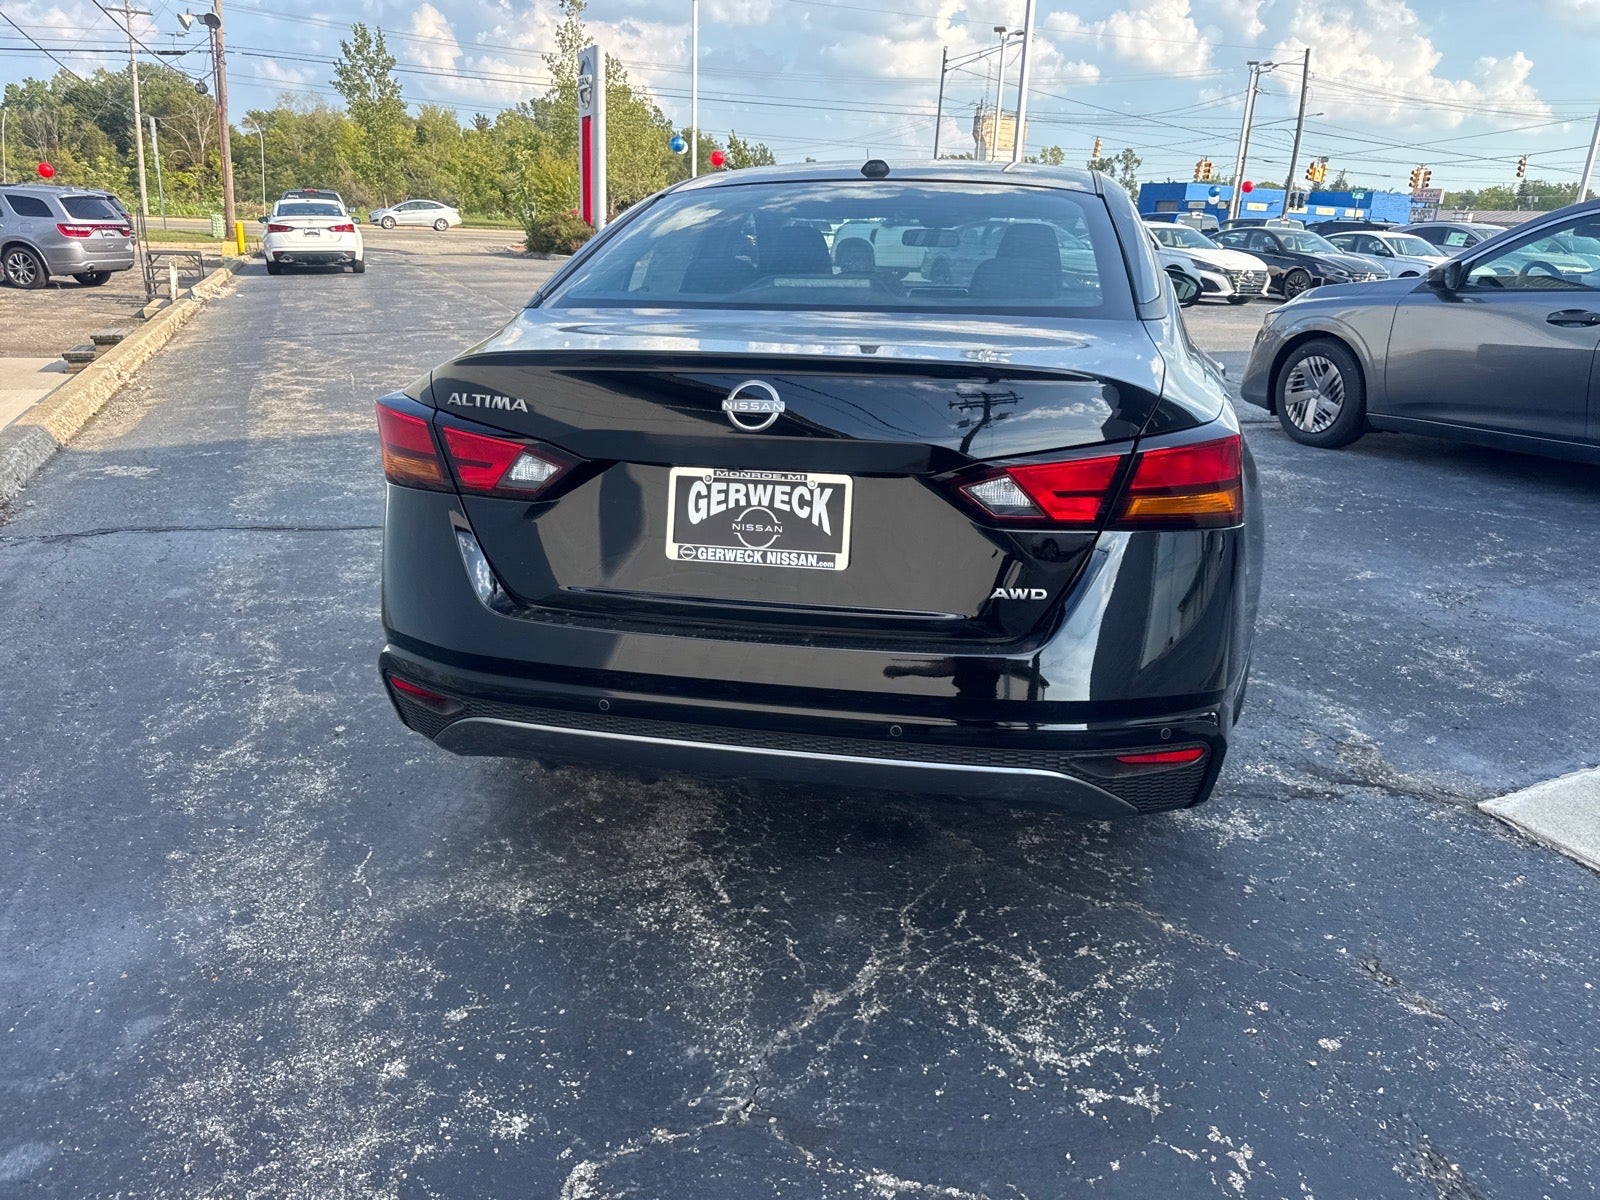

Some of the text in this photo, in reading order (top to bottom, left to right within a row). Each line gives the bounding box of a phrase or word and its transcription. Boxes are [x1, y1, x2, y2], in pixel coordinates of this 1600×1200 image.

[447, 392, 529, 413] ALTIMA
[722, 400, 783, 412] NISSAN
[687, 480, 834, 537] GERWECK
[732, 522, 783, 533] NISSAN
[697, 547, 834, 568] GERWECK NISSAN.com
[989, 587, 1048, 600] AWD
